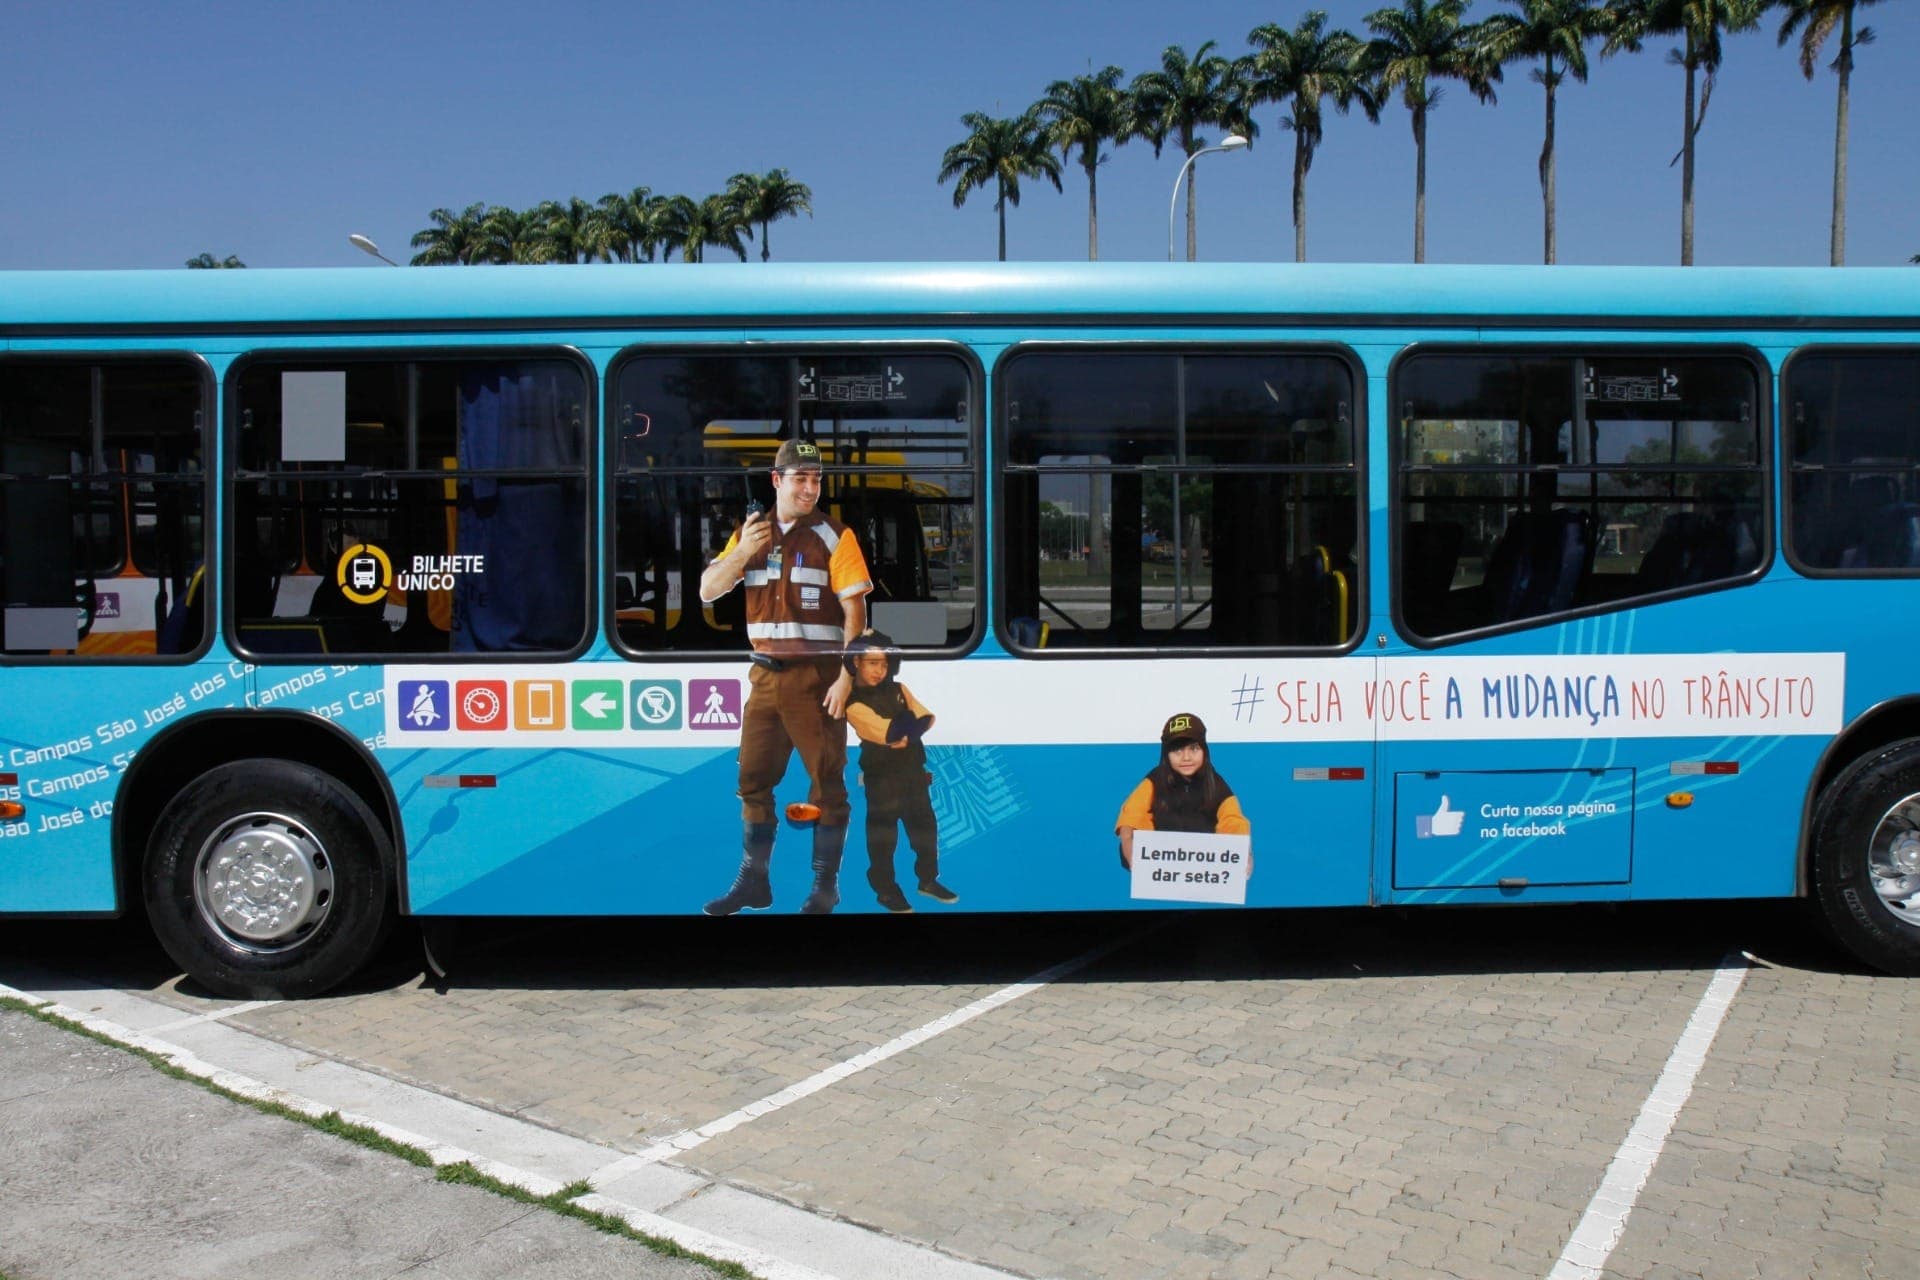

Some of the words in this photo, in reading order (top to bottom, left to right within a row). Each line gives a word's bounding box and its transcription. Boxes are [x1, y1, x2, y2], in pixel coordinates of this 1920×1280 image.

[413, 555, 484, 573] BILHETE
[397, 570, 455, 591] ÚNICO
[245, 668, 326, 711] Campos
[1364, 672, 1431, 722] VOCÊ
[1445, 676, 1462, 720] A
[1482, 673, 1620, 726] MUDANÇA
[1631, 678, 1665, 720] NO
[1683, 670, 1814, 719] TRÂNSITO
[10, 735, 93, 767] Campos
[96, 720, 137, 744] São
[143, 692, 187, 729] José
[189, 673, 226, 701] dos
[27, 764, 110, 797] Campos
[37, 805, 84, 832] José
[89, 800, 113, 819] do
[1480, 803, 1519, 818] Curta
[1524, 805, 1563, 817] nossa
[1567, 800, 1616, 817] página
[1480, 826, 1498, 838] no
[1502, 821, 1566, 838] facebook
[1141, 847, 1215, 863] Lembrou
[1220, 850, 1240, 863] de
[1152, 869, 1180, 882] dar
[1185, 871, 1230, 884] seta?
